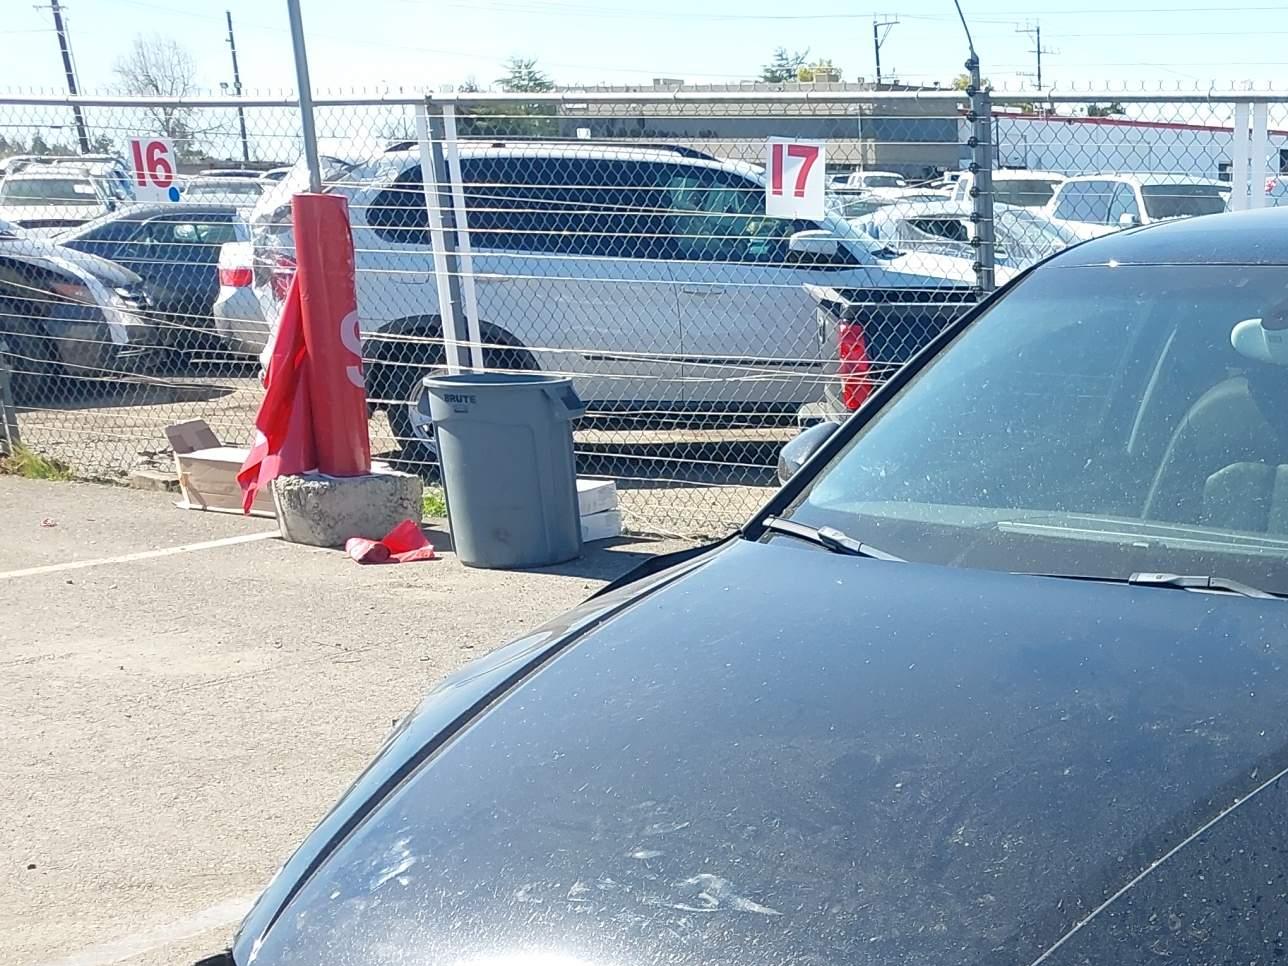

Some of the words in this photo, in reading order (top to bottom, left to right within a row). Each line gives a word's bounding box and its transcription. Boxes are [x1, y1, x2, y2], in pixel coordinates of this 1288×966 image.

[131, 140, 173, 188] 16
[772, 143, 819, 197] 17
[443, 393, 477, 404] BRUTE
